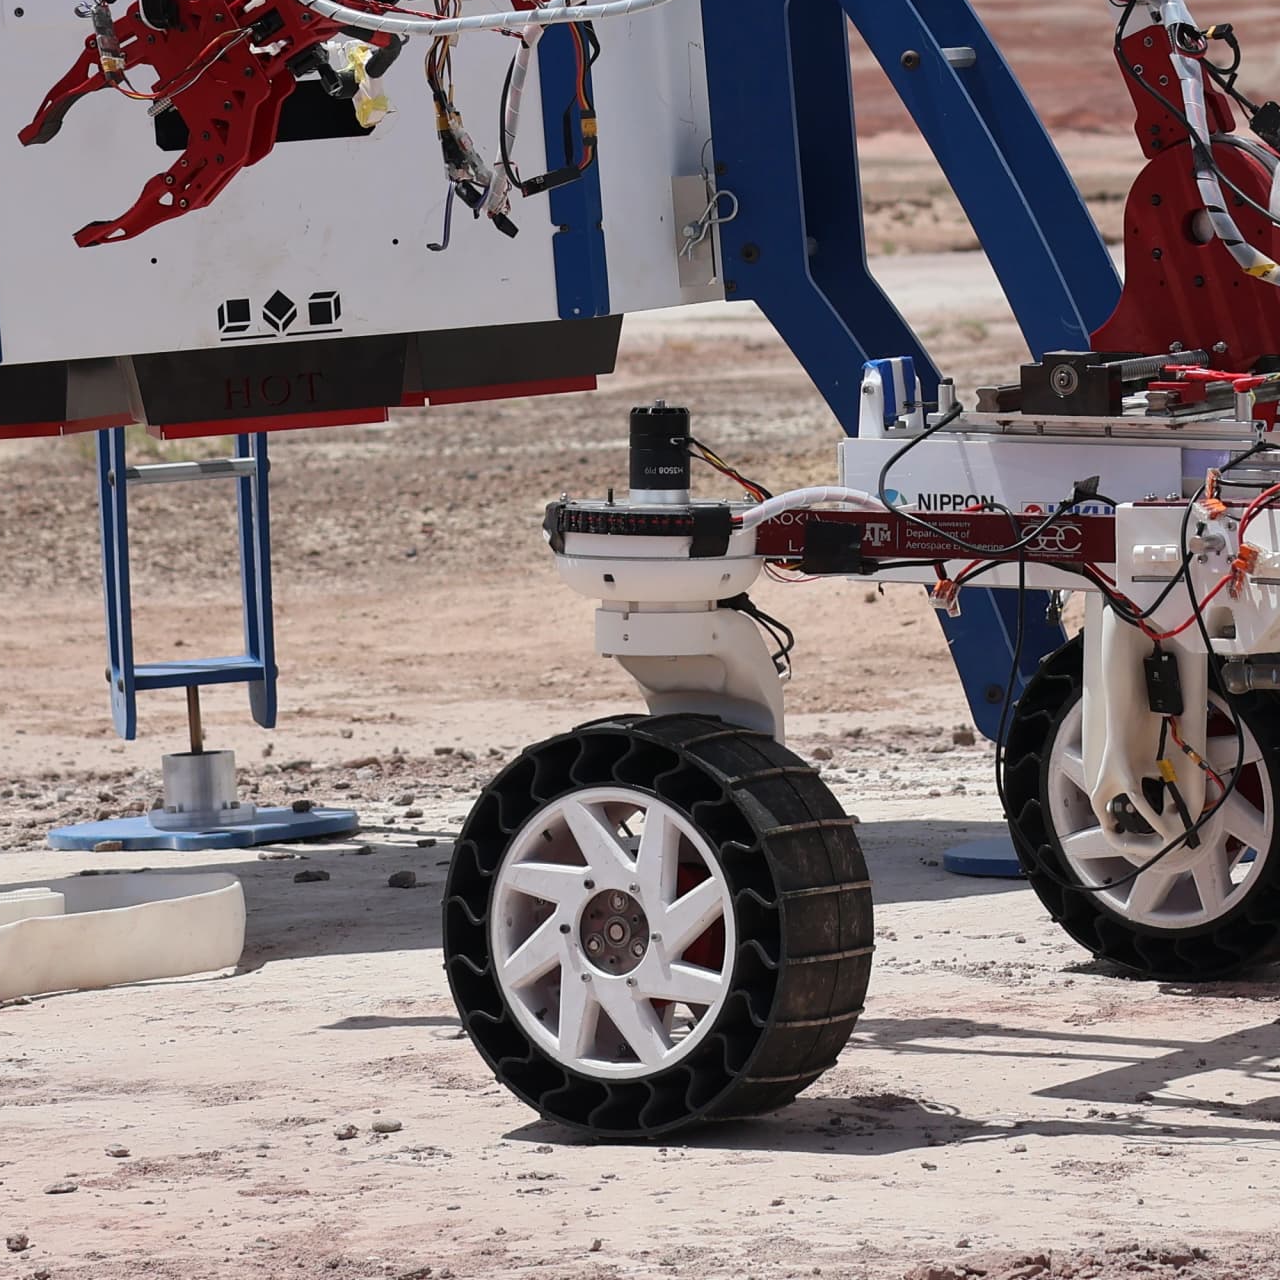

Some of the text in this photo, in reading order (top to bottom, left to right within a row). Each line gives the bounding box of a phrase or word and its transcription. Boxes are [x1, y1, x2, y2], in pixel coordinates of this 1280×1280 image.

[224, 372, 324, 410] HOT
[917, 493, 994, 512] NIPPON
[906, 541, 952, 551] Aerospace
